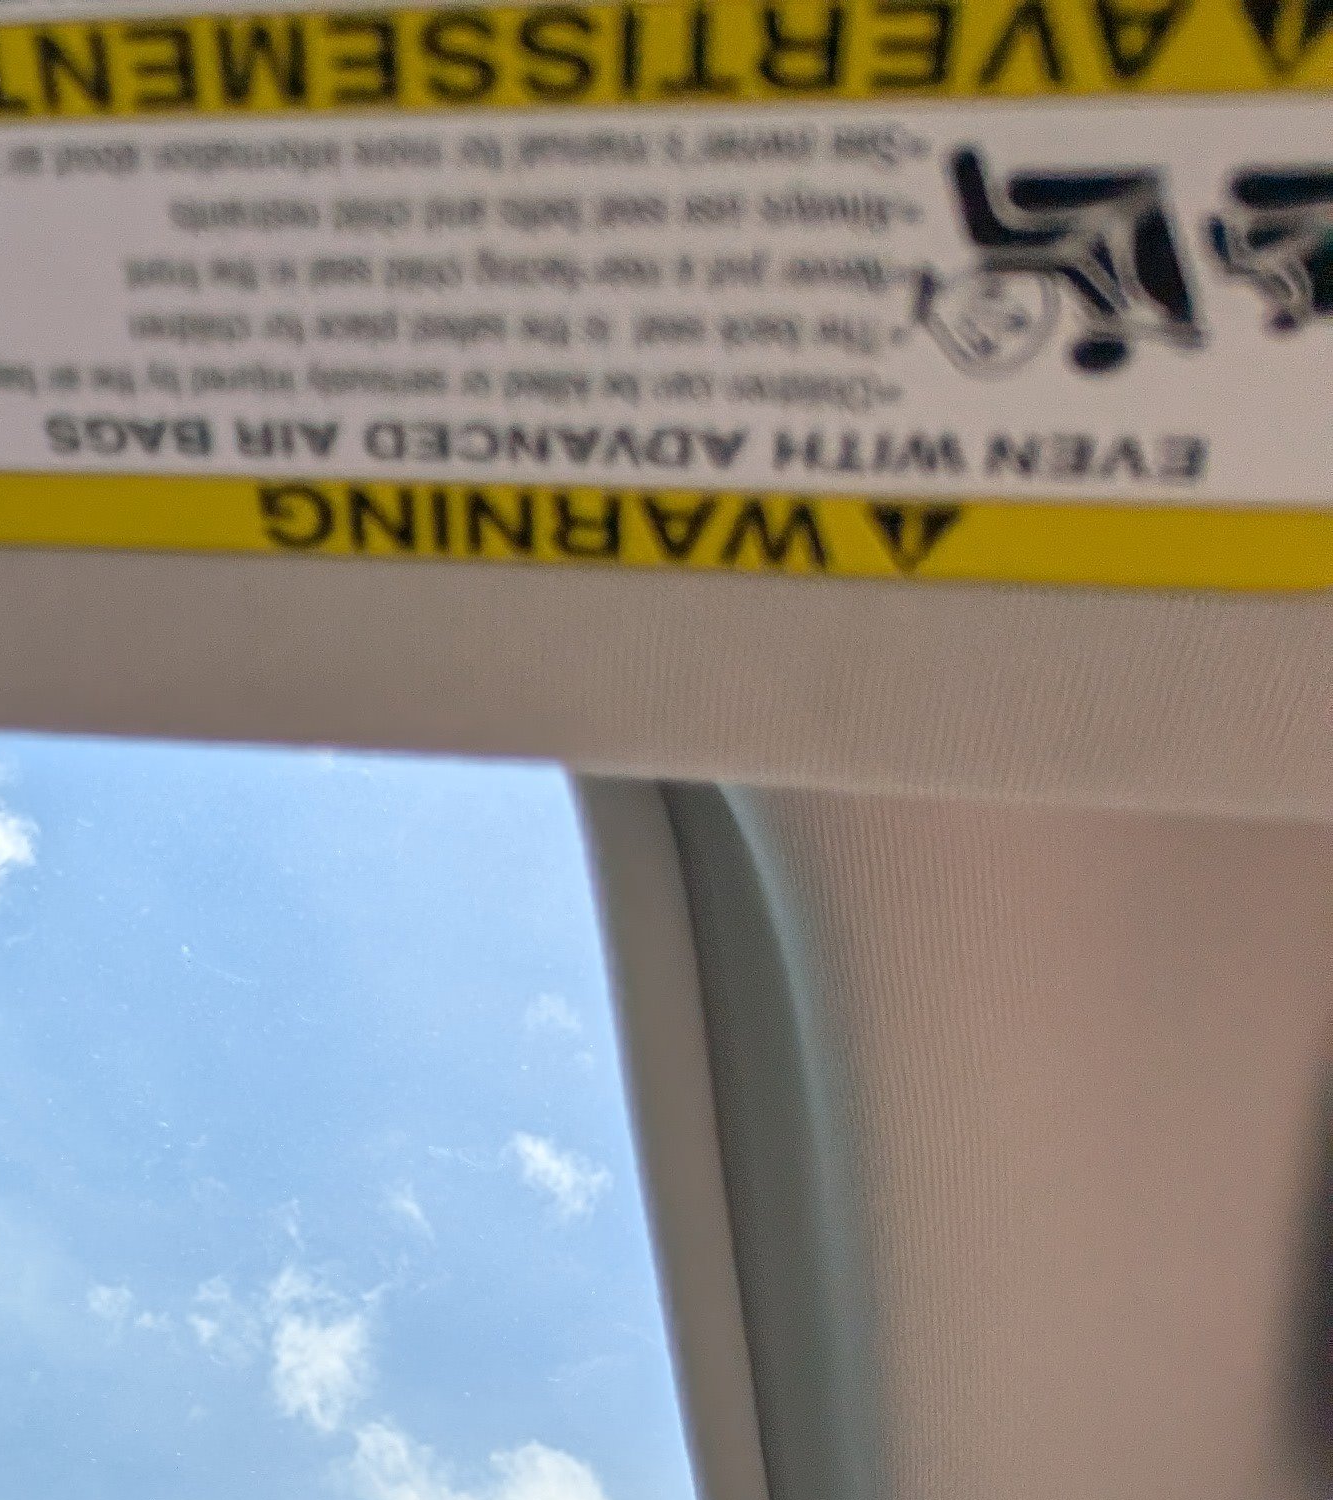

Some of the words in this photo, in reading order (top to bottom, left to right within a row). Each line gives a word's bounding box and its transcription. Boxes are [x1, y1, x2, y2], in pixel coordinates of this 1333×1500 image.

[7, 150, 43, 182] air
[53, 143, 139, 181] about
[155, 140, 341, 180] information
[354, 140, 445, 170] more
[459, 140, 502, 176] for
[520, 136, 646, 173] manual
[334, 201, 411, 233] child
[423, 201, 485, 232] and
[123, 259, 200, 294] front
[211, 260, 259, 294] the
[310, 259, 372, 291] seat
[386, 257, 463, 292] child
[125, 313, 250, 349] children
[261, 315, 304, 349] for
[317, 308, 397, 345] place
[410, 314, 507, 349] safest
[522, 316, 571, 350] the
[636, 314, 706, 345] seat
[818, 316, 874, 350] The
[90, 365, 136, 399] the
[146, 360, 180, 400] by
[191, 360, 293, 402] injured
[599, 371, 639, 406] be
[652, 371, 716, 400] can
[41, 414, 215, 458] BAGS
[235, 419, 340, 460] AIR
[363, 420, 748, 472] ADVANCED
[774, 430, 965, 478] WITH
[983, 434, 1208, 487] EVEN
[257, 485, 828, 571] WARNING
